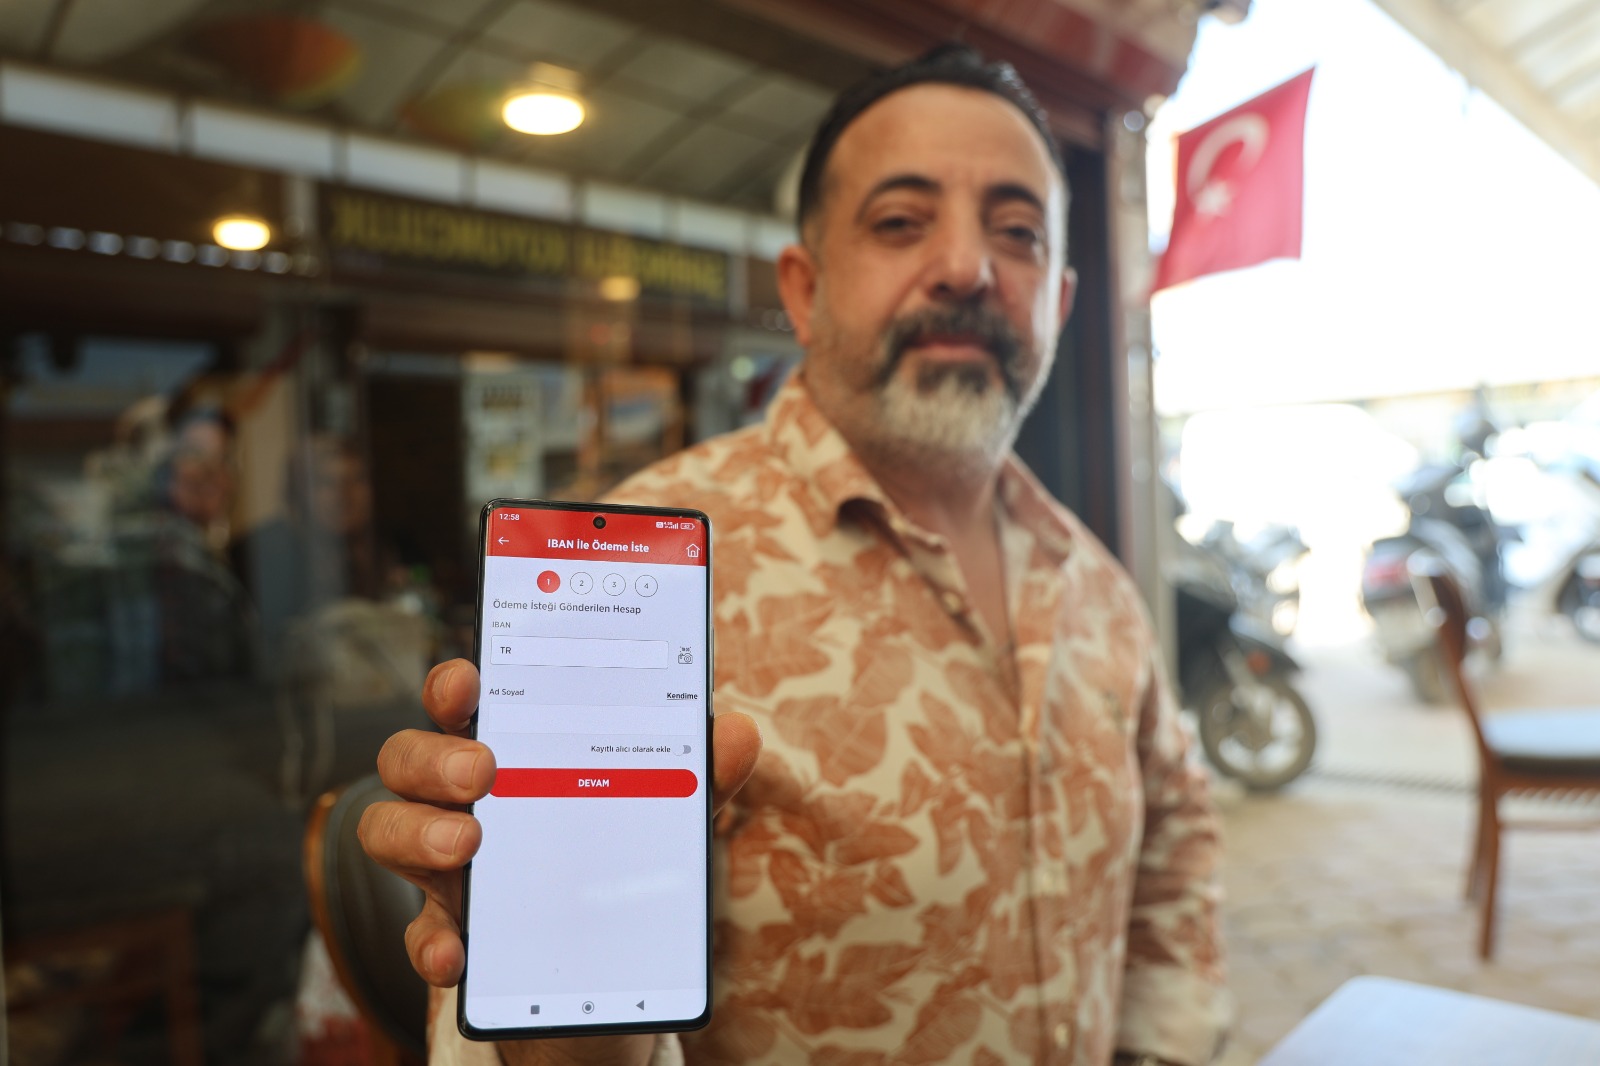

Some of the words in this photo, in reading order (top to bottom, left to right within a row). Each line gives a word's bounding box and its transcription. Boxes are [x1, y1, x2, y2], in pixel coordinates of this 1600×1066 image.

[499, 513, 520, 521] 12:58
[547, 538, 574, 549] IBAN
[576, 539, 589, 550] İle
[592, 537, 628, 552] Ödeme
[631, 540, 650, 553] İste
[579, 579, 584, 587] 2
[643, 582, 649, 590] 4
[493, 599, 528, 610] Ödeme
[530, 599, 557, 612] İsteği
[559, 601, 611, 613] Gönderilen
[613, 604, 641, 615] Hesap
[492, 621, 511, 629] IBAN
[500, 646, 512, 655] TR
[489, 688, 500, 696] Ad
[501, 688, 525, 697] Soyad
[666, 692, 698, 700] Kendime
[591, 745, 614, 754] Kayıtlı
[578, 779, 610, 788] DEVAM
